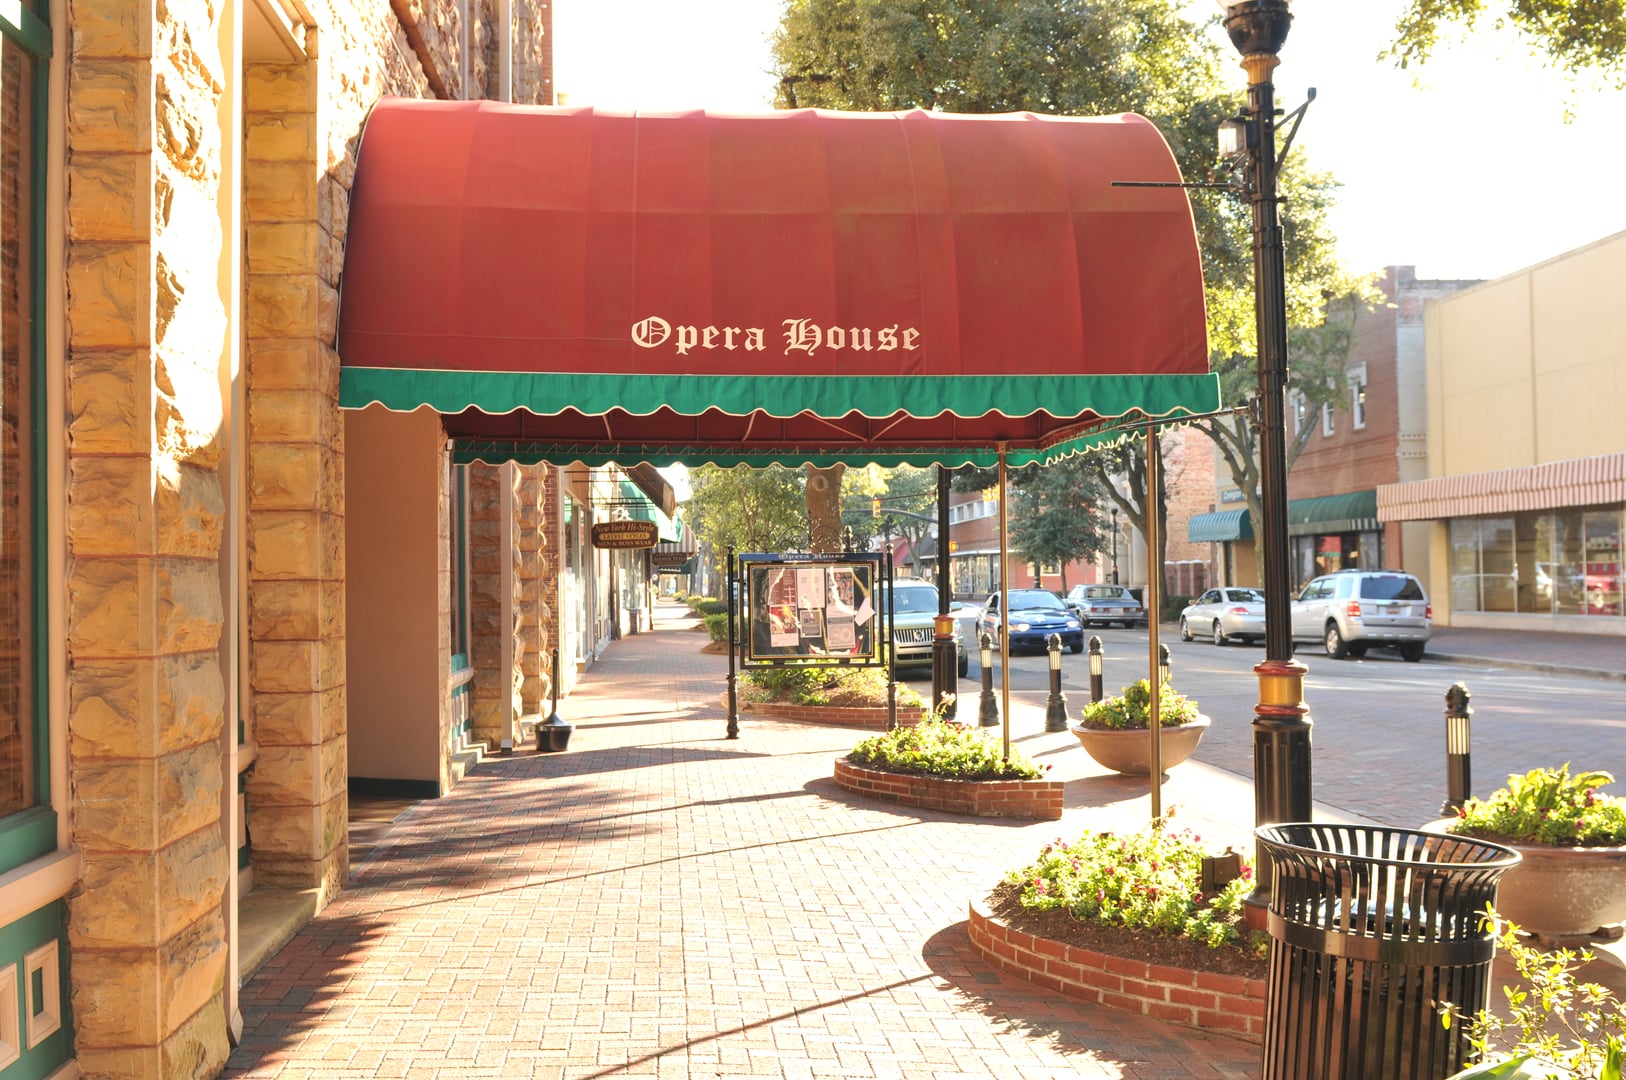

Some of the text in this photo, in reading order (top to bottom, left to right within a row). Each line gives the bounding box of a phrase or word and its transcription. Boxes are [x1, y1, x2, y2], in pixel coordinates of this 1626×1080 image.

[631, 315, 920, 356] Opera House
[611, 523, 625, 532] York
